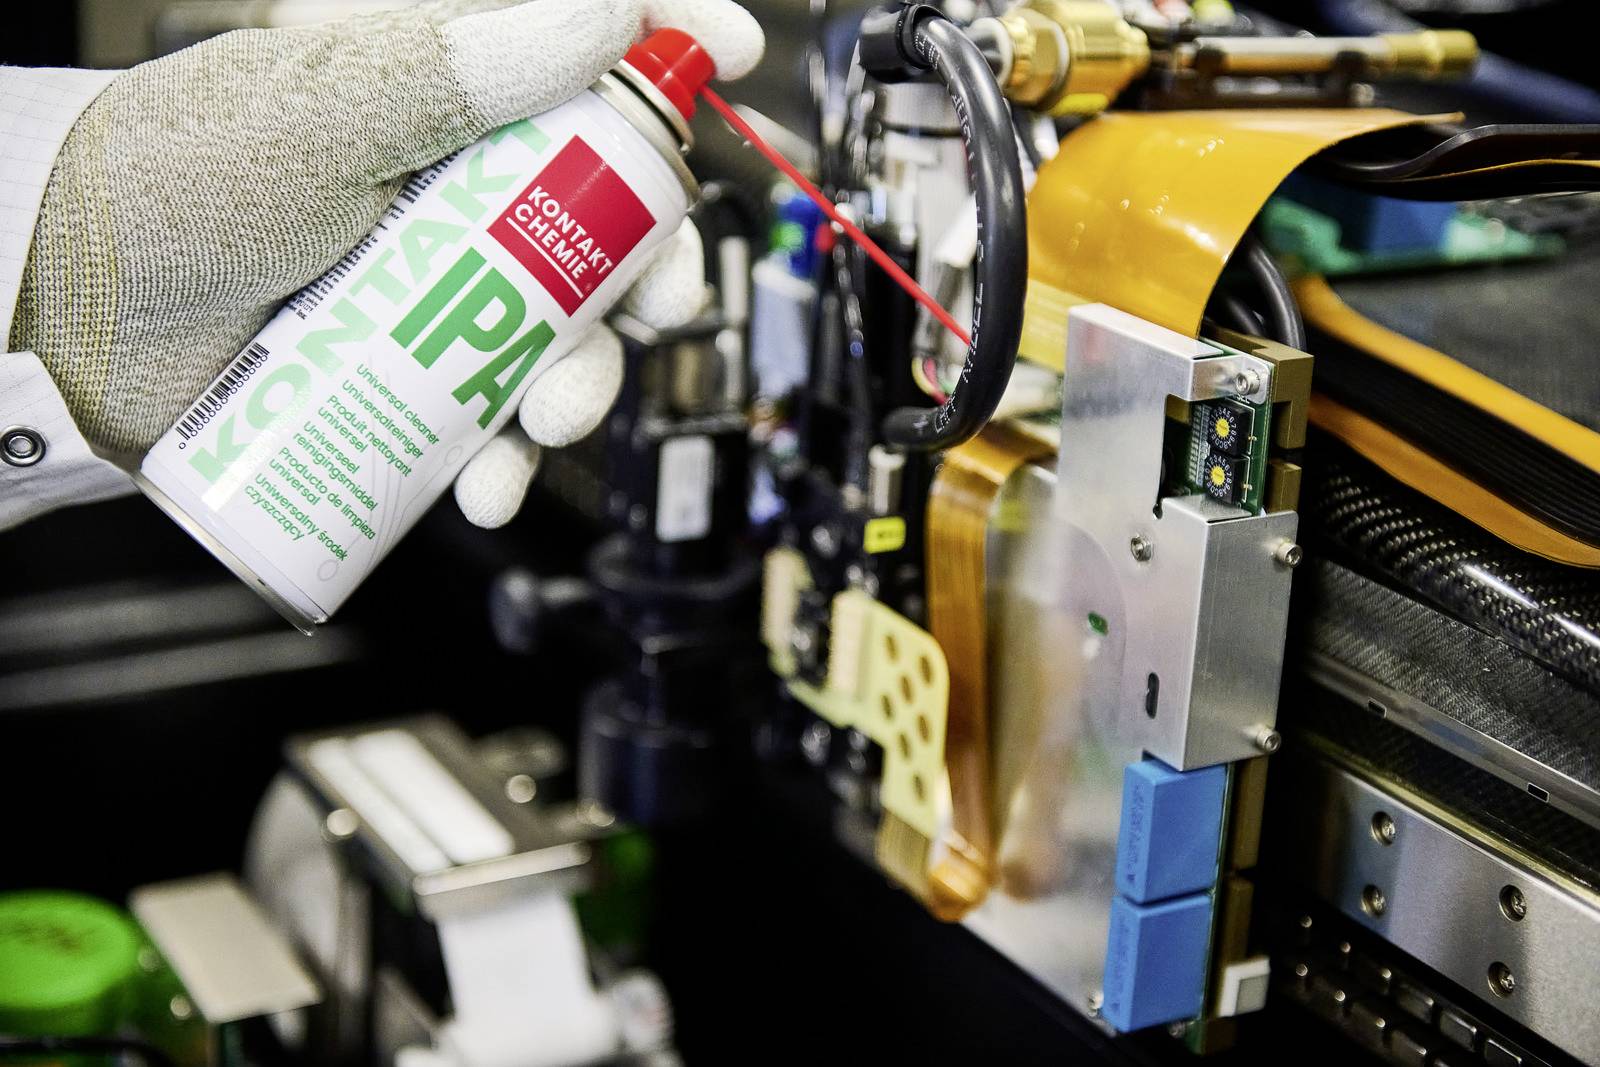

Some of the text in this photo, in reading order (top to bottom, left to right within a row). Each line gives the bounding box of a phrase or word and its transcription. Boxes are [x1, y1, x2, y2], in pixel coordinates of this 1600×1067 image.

[514, 203, 588, 279] CHEMIE
[528, 185, 613, 274] KONTAKT
[187, 118, 552, 486] KONTAKT
[389, 246, 556, 431] IPA
[317, 406, 369, 453] universel
[327, 394, 413, 478] Produit nettoyant
[341, 378, 424, 460] Universalreiniger
[356, 363, 440, 446] Universal cleaner
[269, 458, 321, 506] universal
[292, 432, 379, 512] reinigingsmiddel
[303, 420, 360, 475] Universeel
[244, 484, 305, 541] czyszczący
[255, 472, 348, 562] Uniwersalny środek
[278, 446, 377, 541] Producto de limpieza
